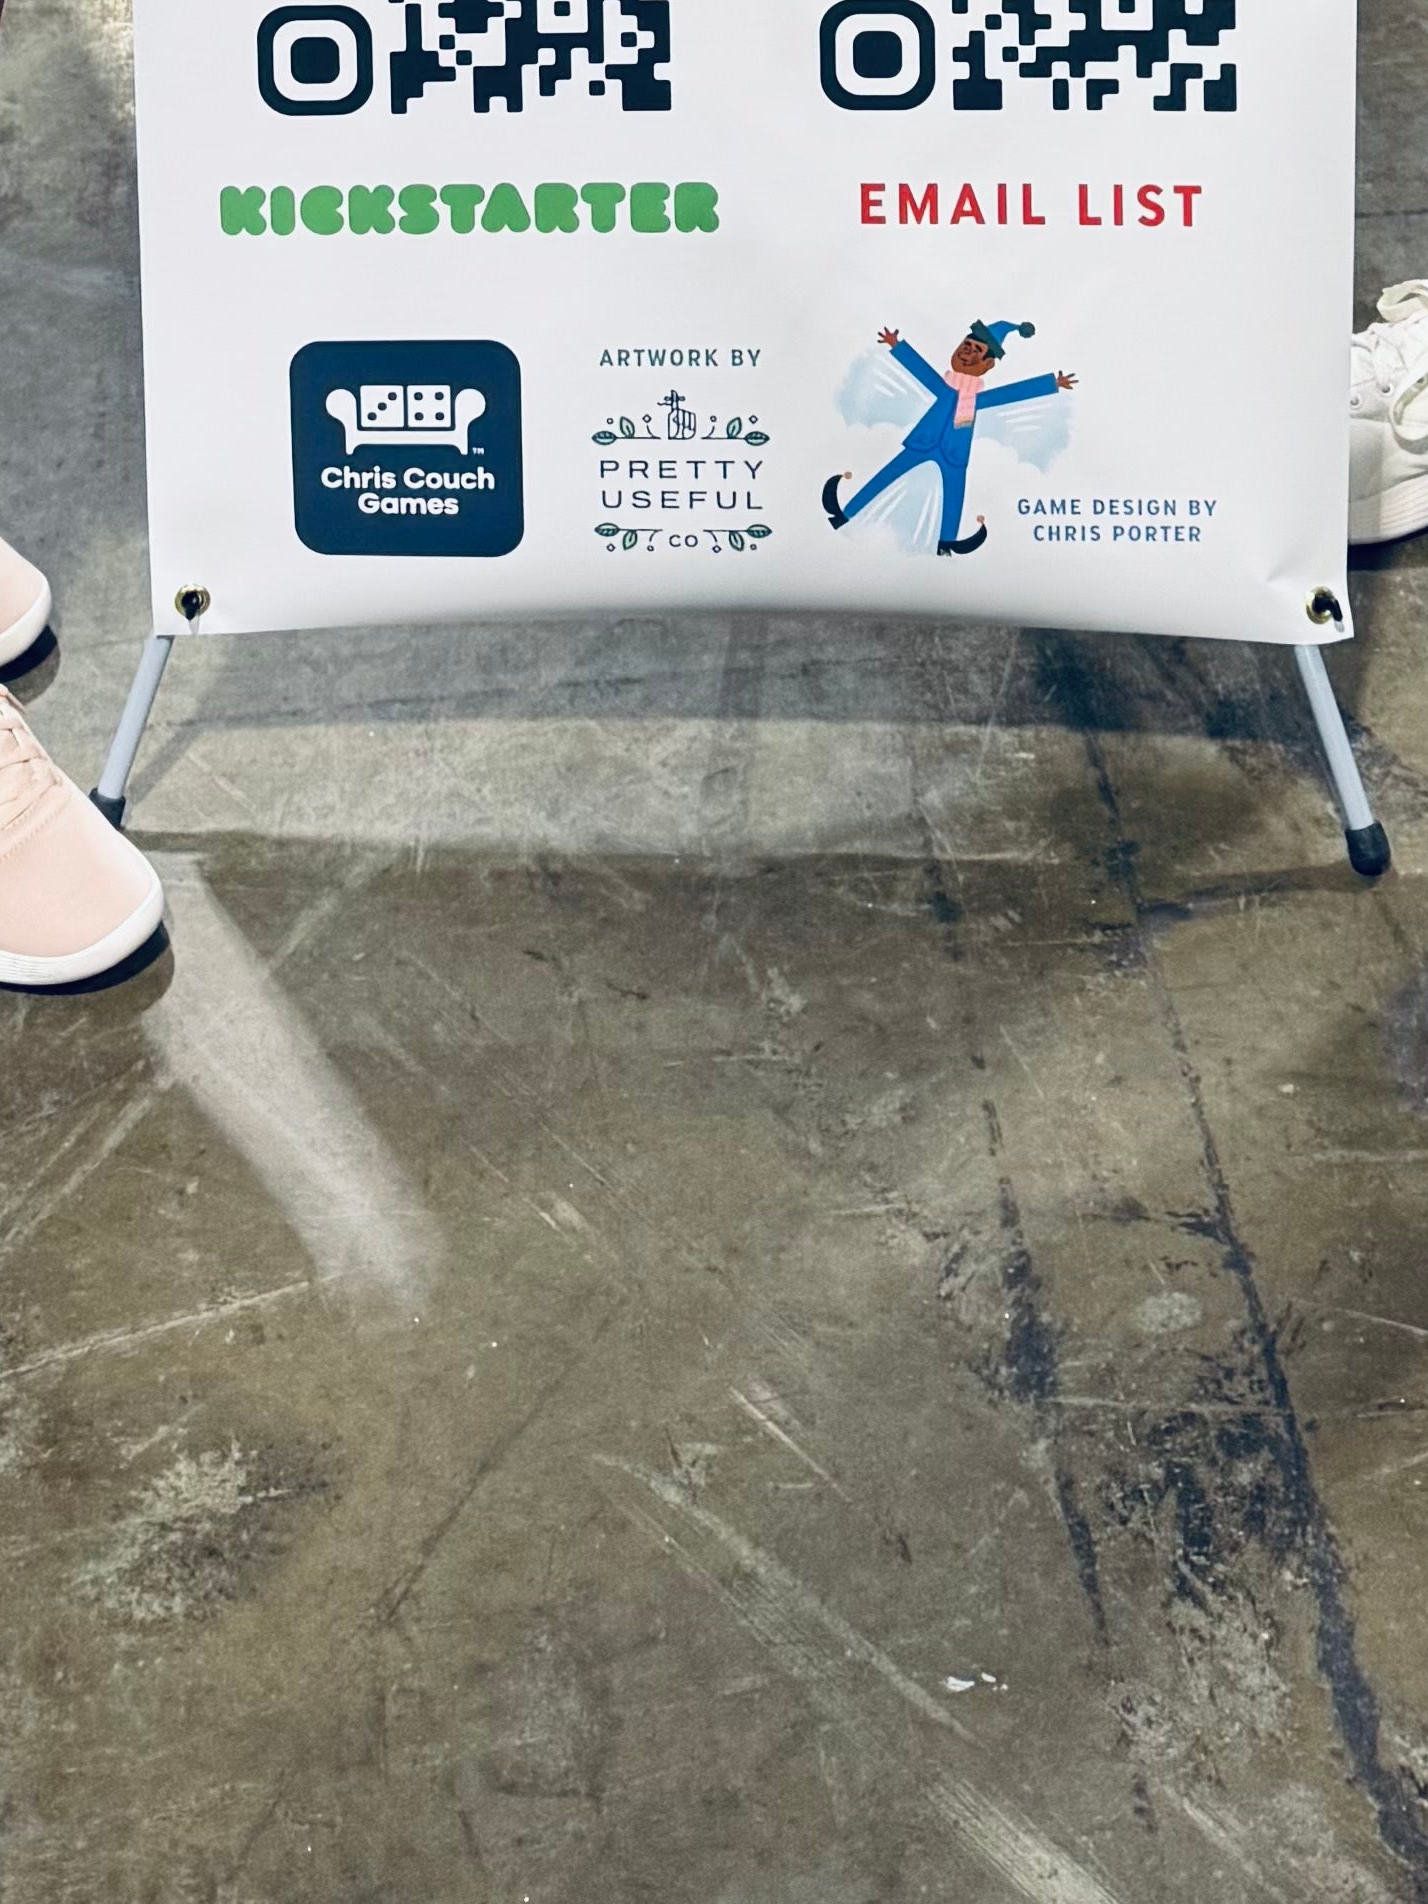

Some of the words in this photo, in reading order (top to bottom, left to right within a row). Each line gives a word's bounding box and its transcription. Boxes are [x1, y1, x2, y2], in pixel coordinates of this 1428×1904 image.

[219, 181, 720, 236] KICKSTARTER
[860, 182, 1045, 226] EMAIL
[1078, 184, 1202, 228] LIST
[599, 348, 719, 367] ARTWORK
[731, 348, 761, 367] BY
[321, 465, 397, 489] Chris
[402, 466, 496, 490] Couch
[600, 460, 763, 480] PRETTY
[357, 492, 460, 515] Games
[601, 490, 763, 510] USEFUL
[1017, 498, 1082, 515] GAME
[1092, 499, 1177, 516] DESIGN
[1188, 499, 1217, 517] BY
[668, 534, 699, 548] CO
[1033, 525, 1101, 542] CHRIS
[1112, 525, 1201, 543] PORTER
